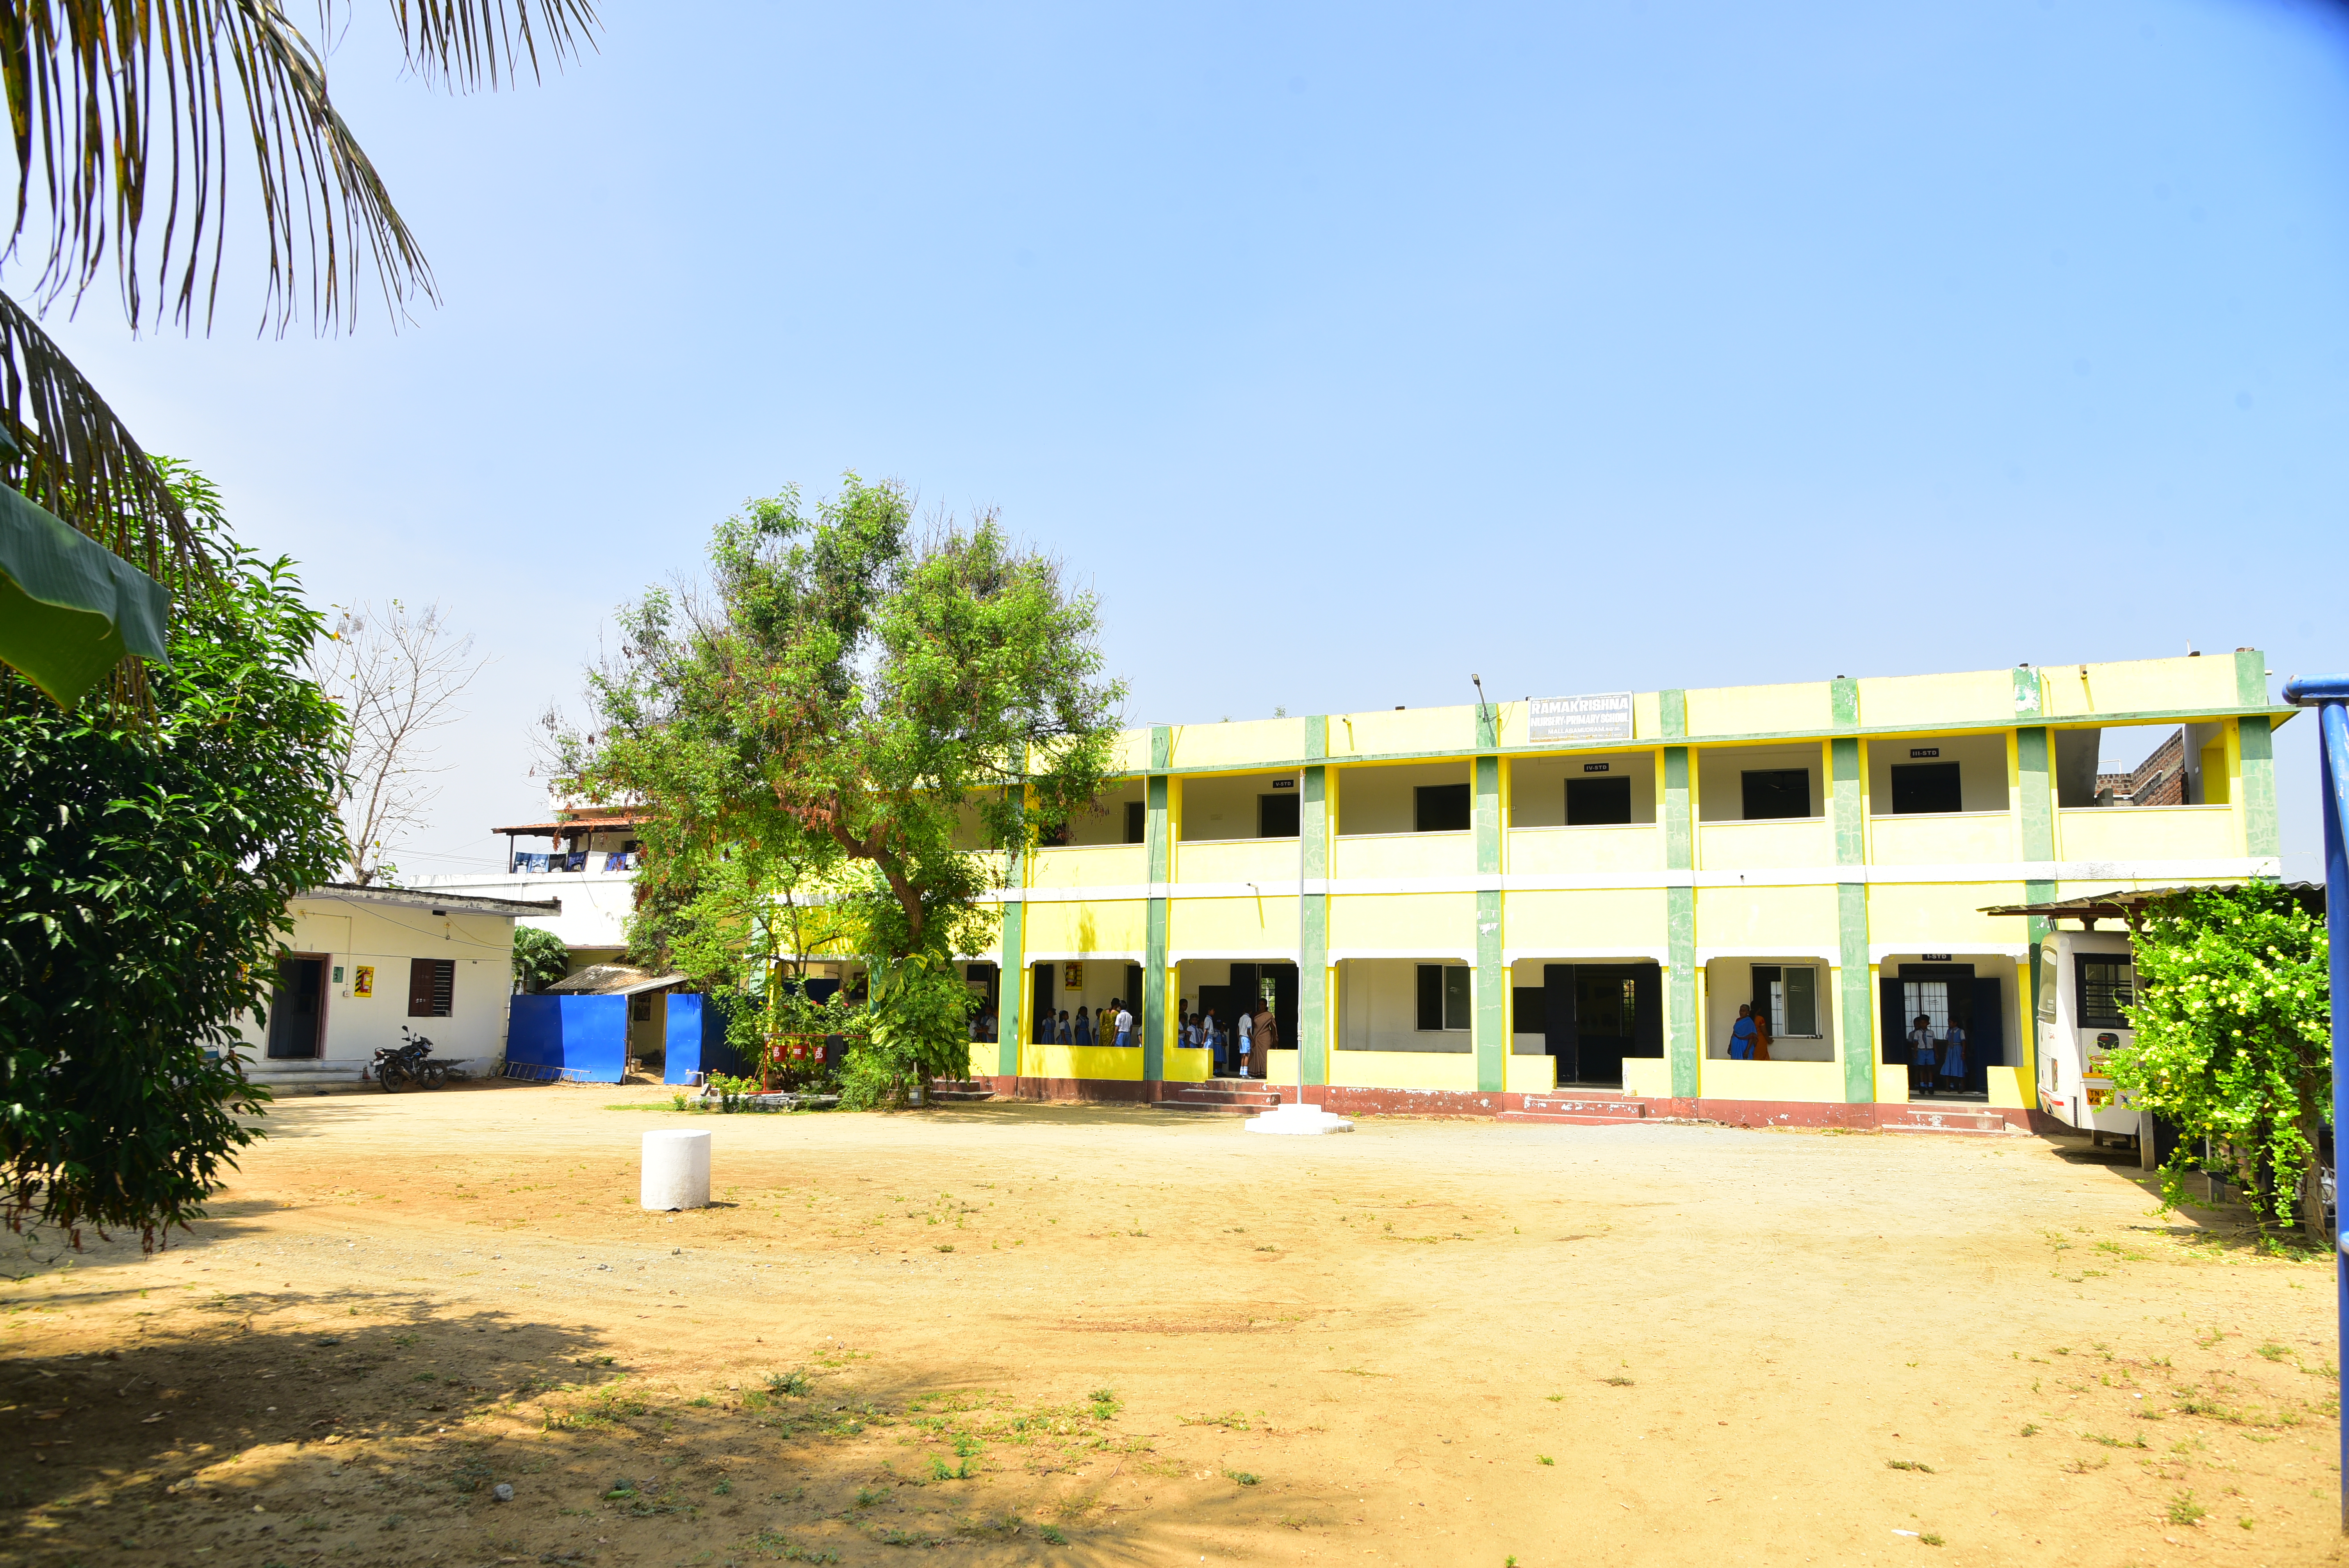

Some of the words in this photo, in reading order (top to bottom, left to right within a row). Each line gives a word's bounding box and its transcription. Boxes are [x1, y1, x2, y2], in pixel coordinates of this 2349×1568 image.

[1531, 698, 1628, 715] RAMAKRISHNA
[1530, 716, 1565, 727] NURSERY
[1566, 714, 1600, 725] PRIMARY
[1600, 712, 1629, 723] SCHOOL
